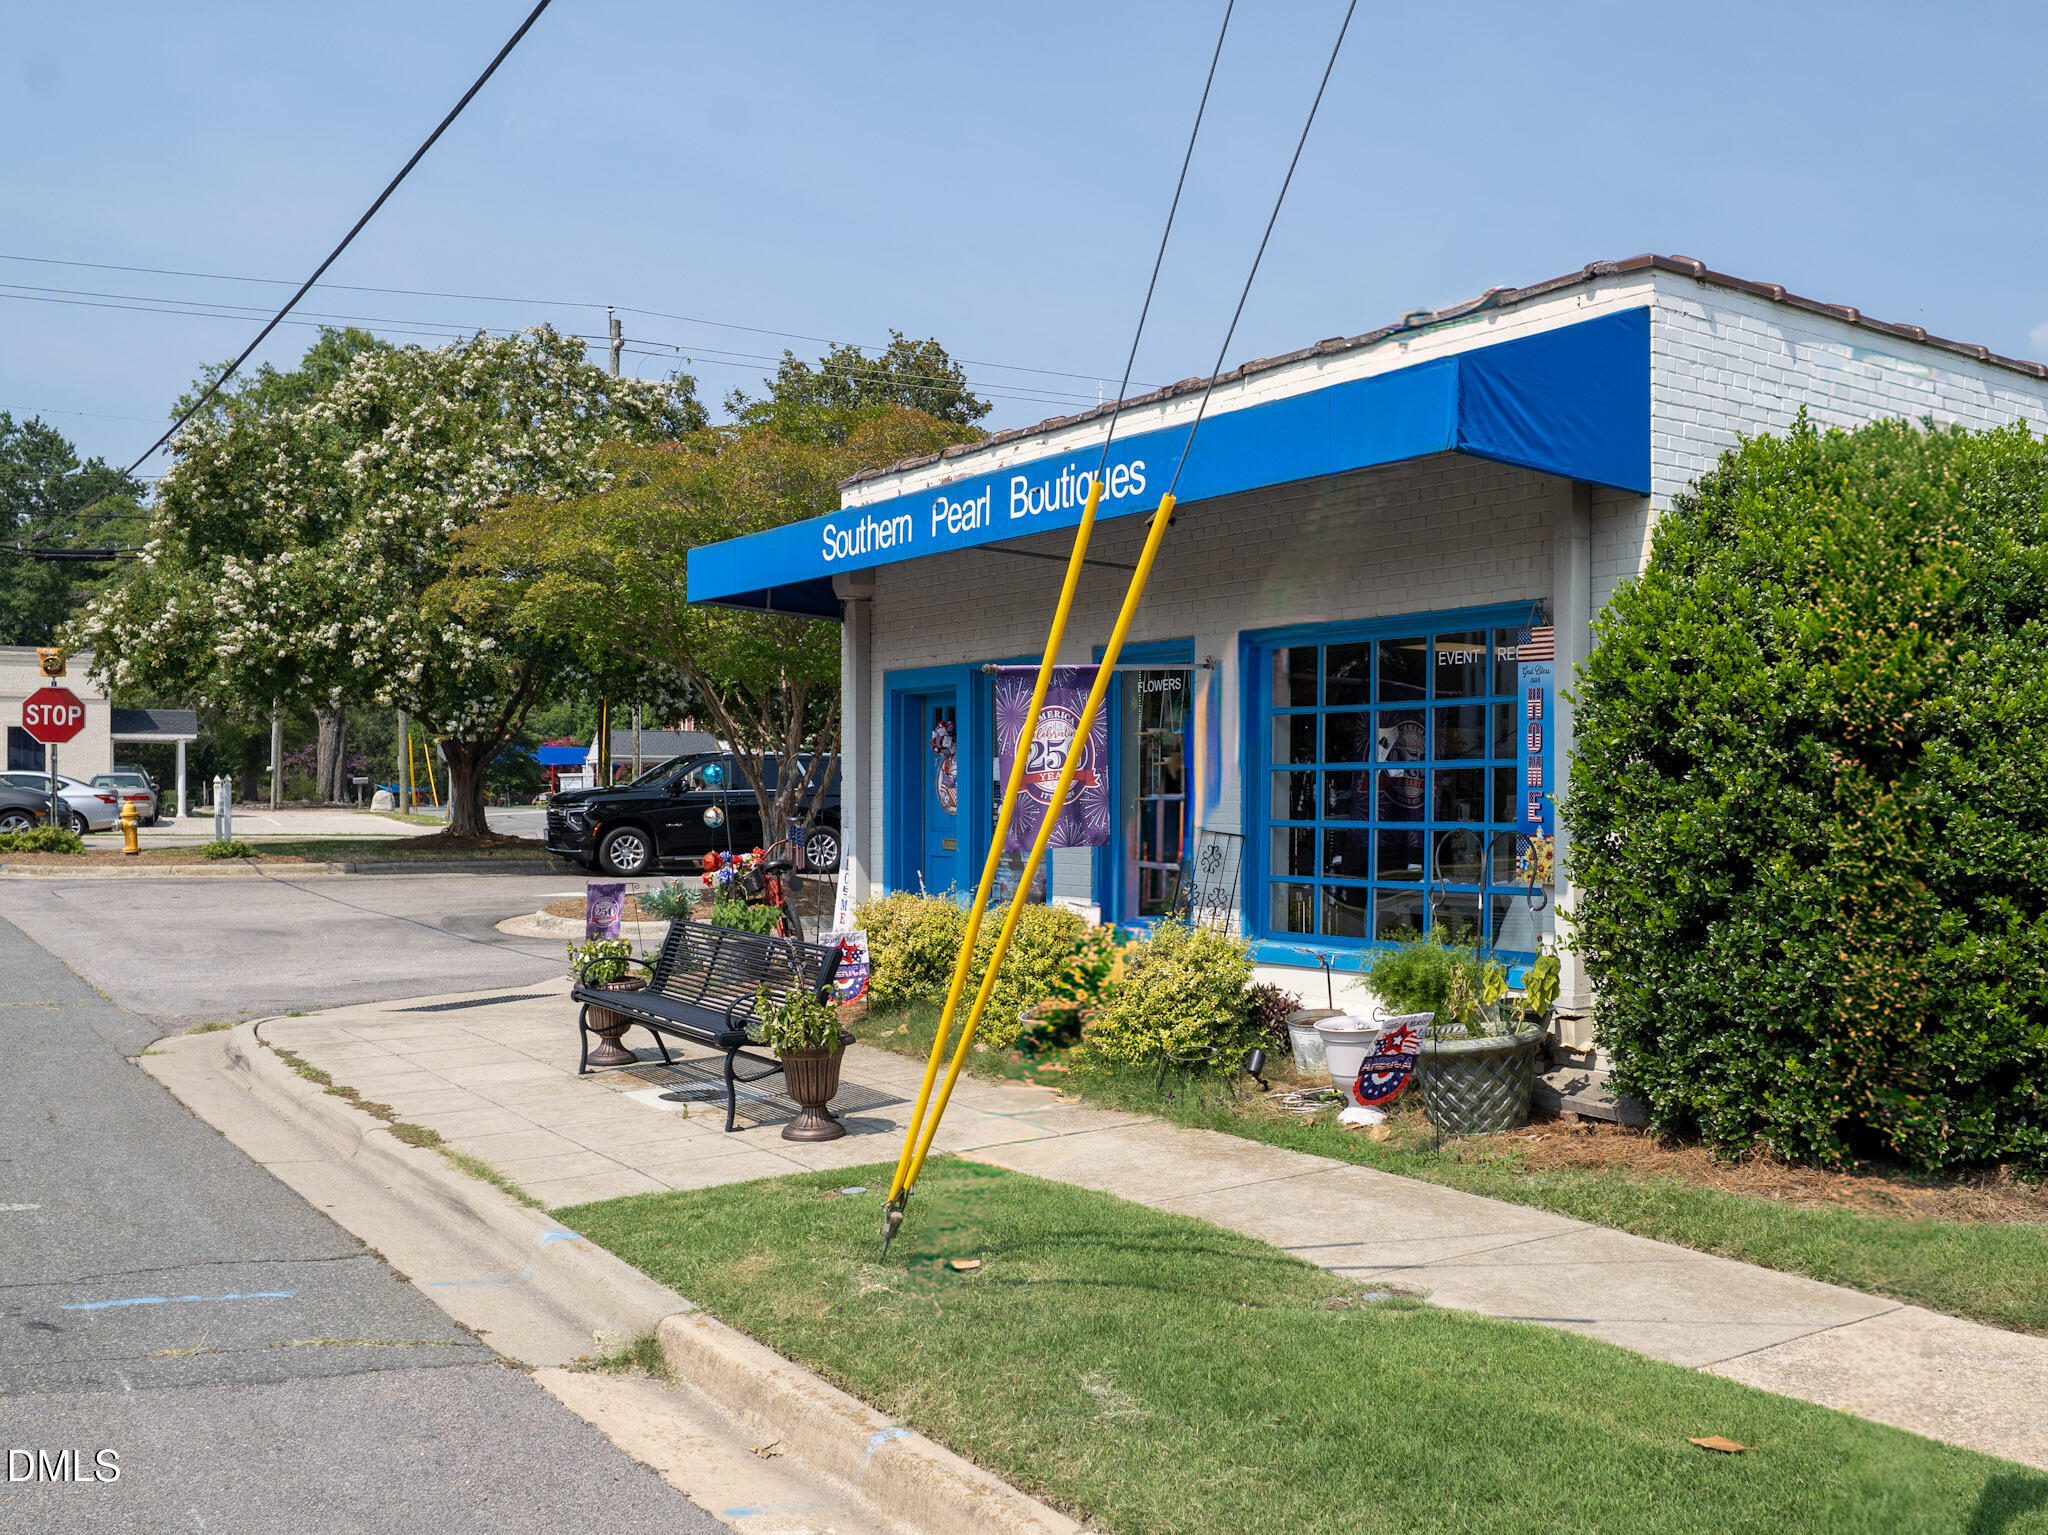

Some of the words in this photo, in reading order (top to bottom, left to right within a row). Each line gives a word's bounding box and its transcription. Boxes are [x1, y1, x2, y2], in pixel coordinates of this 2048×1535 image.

[822, 514, 912, 561] Southern
[931, 485, 990, 537] Pearl
[1010, 460, 1146, 518] Boutiques
[1438, 649, 1481, 666] EVENT
[1137, 677, 1182, 693] FLOWERS
[25, 703, 82, 727] STOP
[1037, 709, 1076, 726] MERICA
[1039, 771, 1062, 782] YEA
